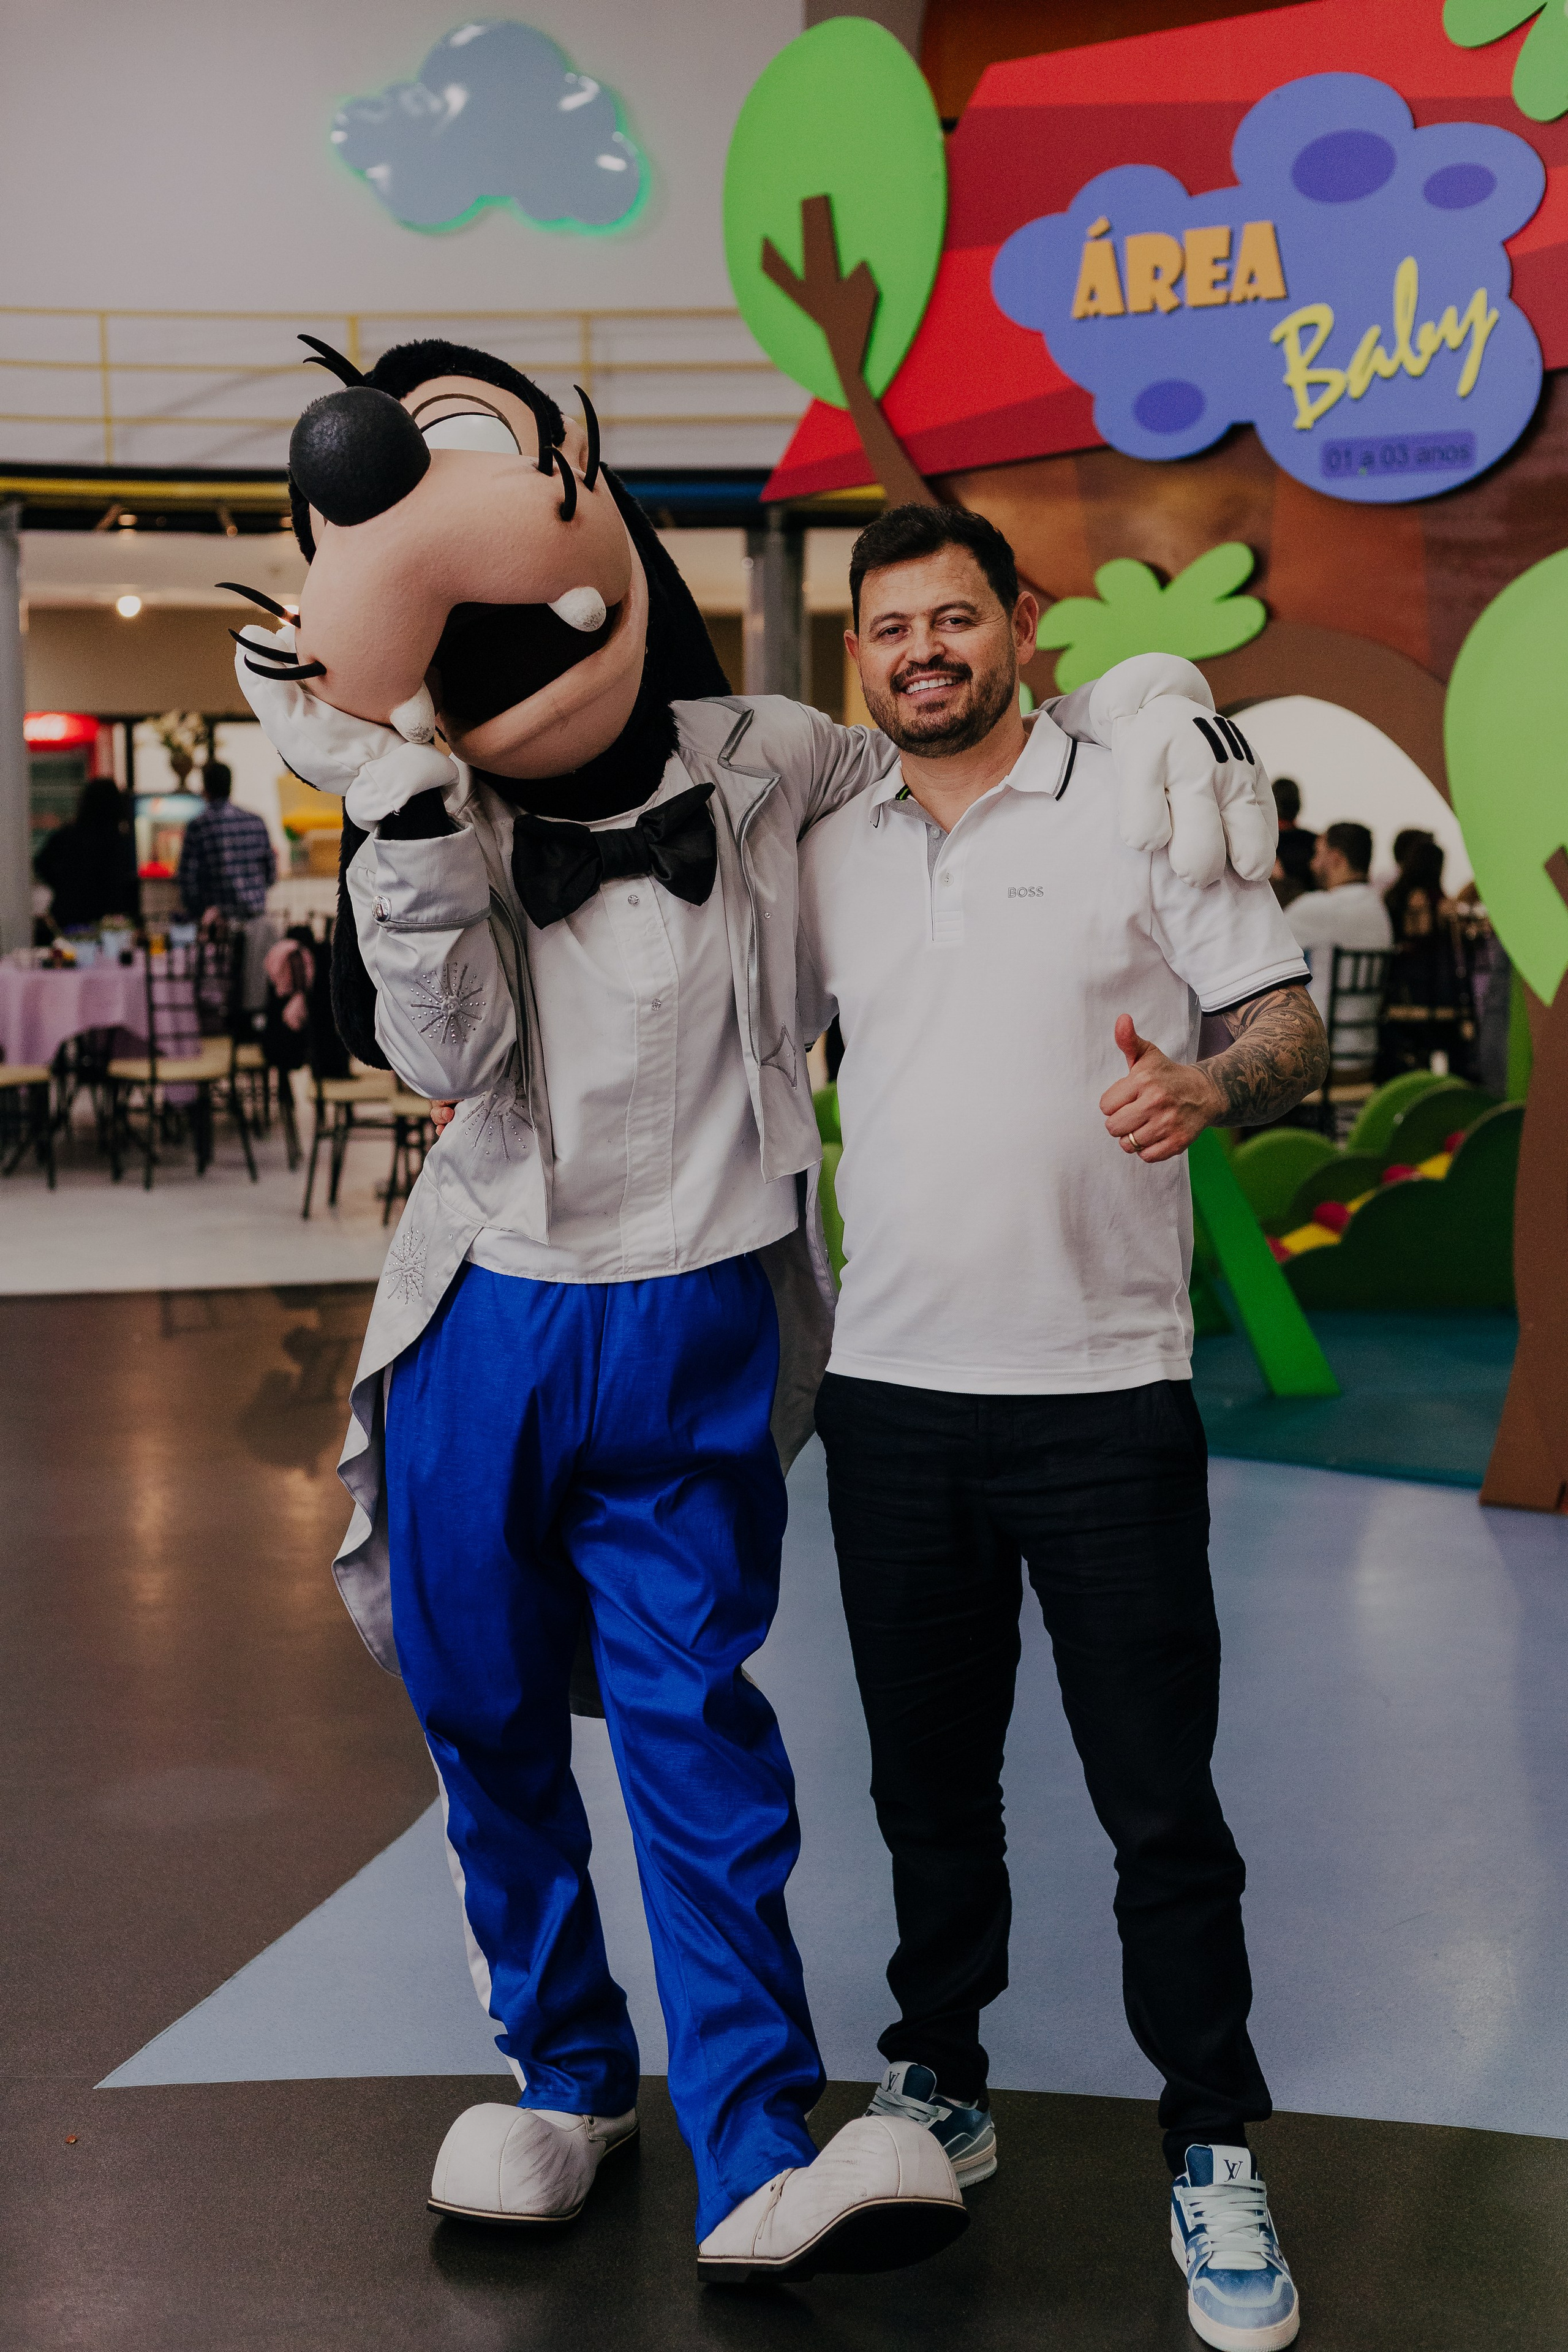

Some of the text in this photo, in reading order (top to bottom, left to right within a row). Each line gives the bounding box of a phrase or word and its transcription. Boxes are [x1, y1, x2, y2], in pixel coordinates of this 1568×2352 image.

[1072, 216, 1287, 319] ÁREA
[1270, 256, 1499, 429] Baby
[1326, 447, 1352, 471] 01
[1416, 443, 1471, 466] anos
[1008, 886, 1044, 899] BOSS
